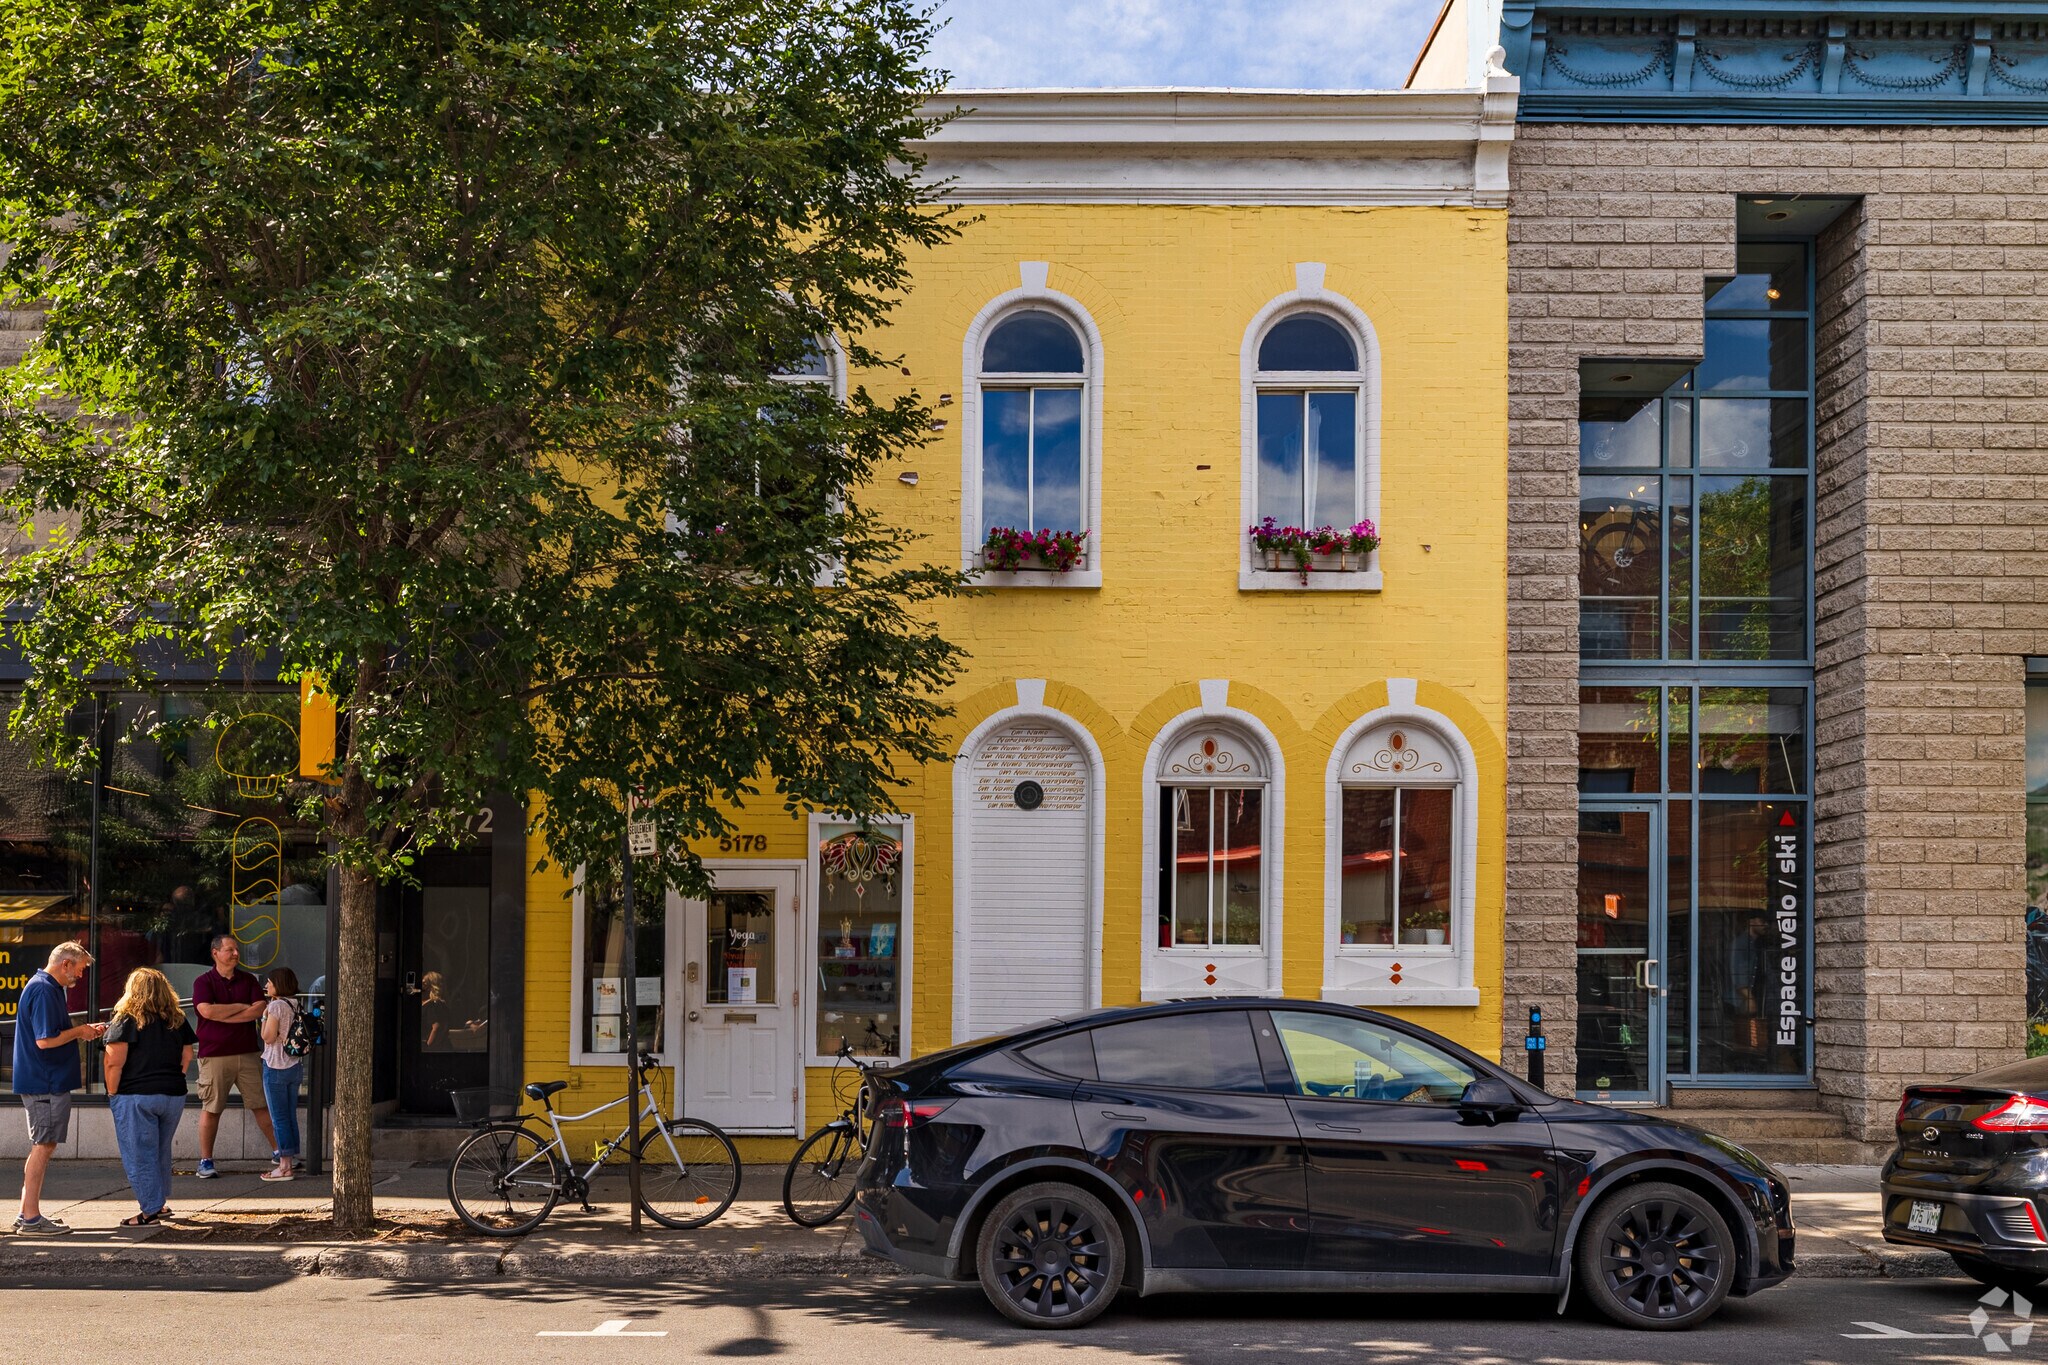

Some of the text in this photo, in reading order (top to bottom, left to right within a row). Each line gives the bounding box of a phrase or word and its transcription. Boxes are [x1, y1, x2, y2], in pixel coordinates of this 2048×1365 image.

[719, 834, 768, 852] 5178
[729, 928, 755, 947] Yoga
[1774, 835, 1802, 1046] Espace vélo / ski
[0, 974, 28, 990] out
